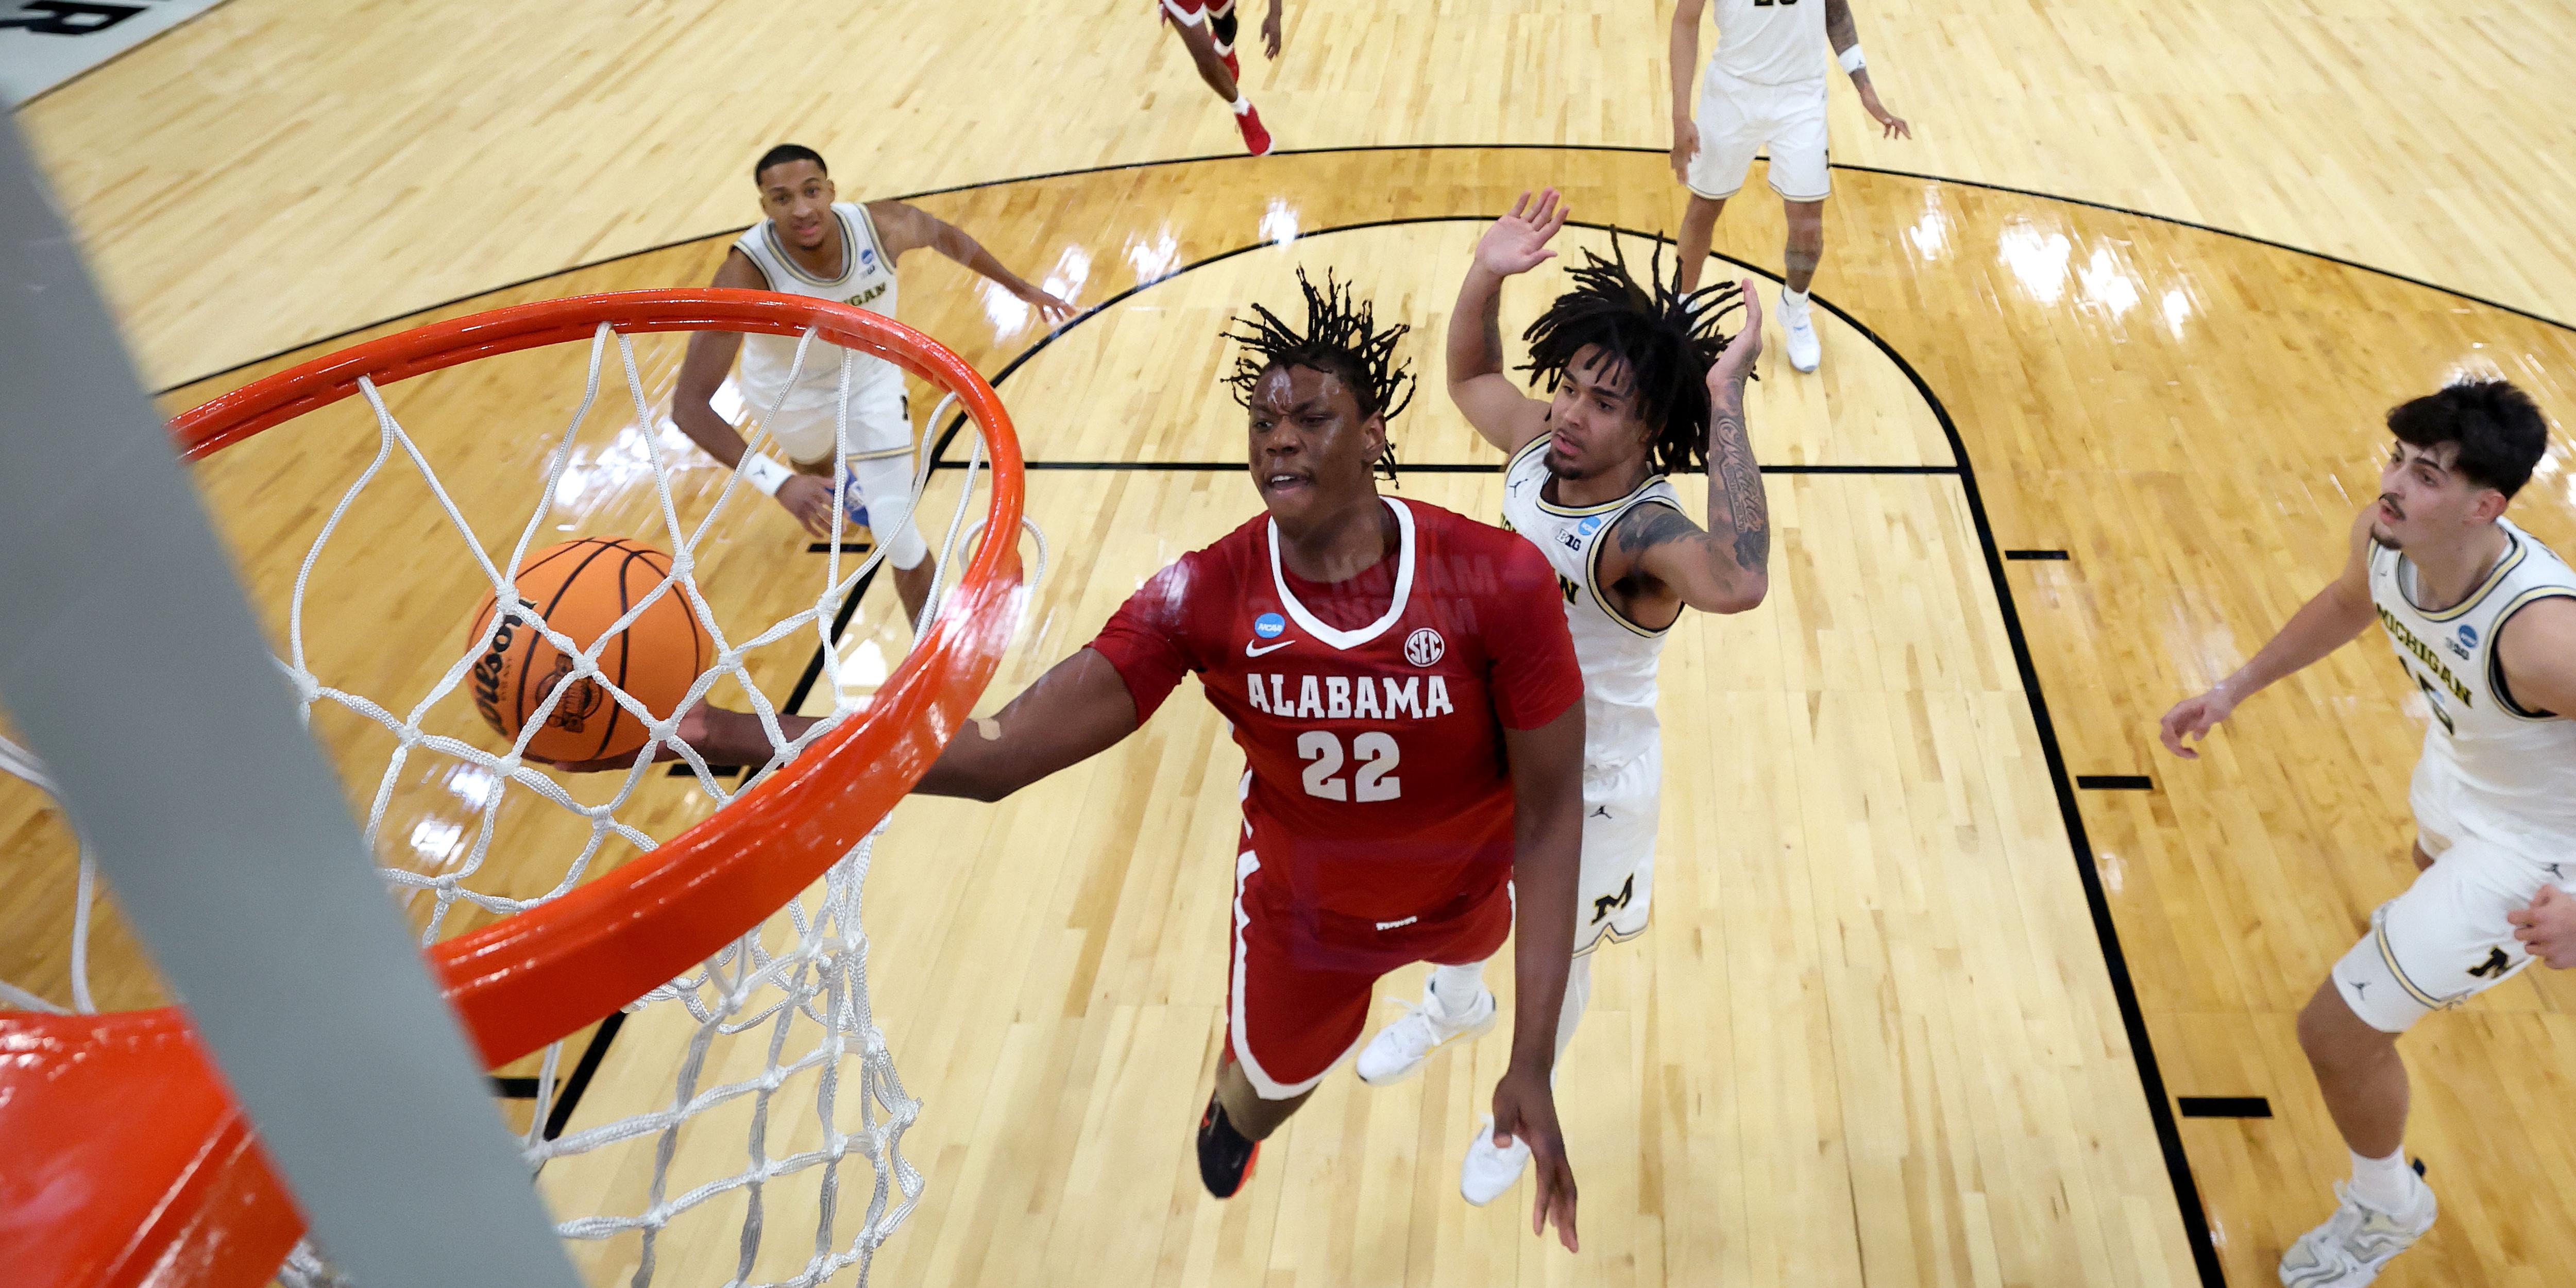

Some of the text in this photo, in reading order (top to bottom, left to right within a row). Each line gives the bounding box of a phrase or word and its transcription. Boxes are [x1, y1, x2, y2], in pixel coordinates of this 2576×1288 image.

[1258, 622, 1283, 632] NCAA
[1407, 630, 1442, 664] SEC
[2376, 602, 2473, 709] MICHIGAN
[1247, 673, 1454, 720] ALABAMA
[1296, 730, 1401, 803] 22
